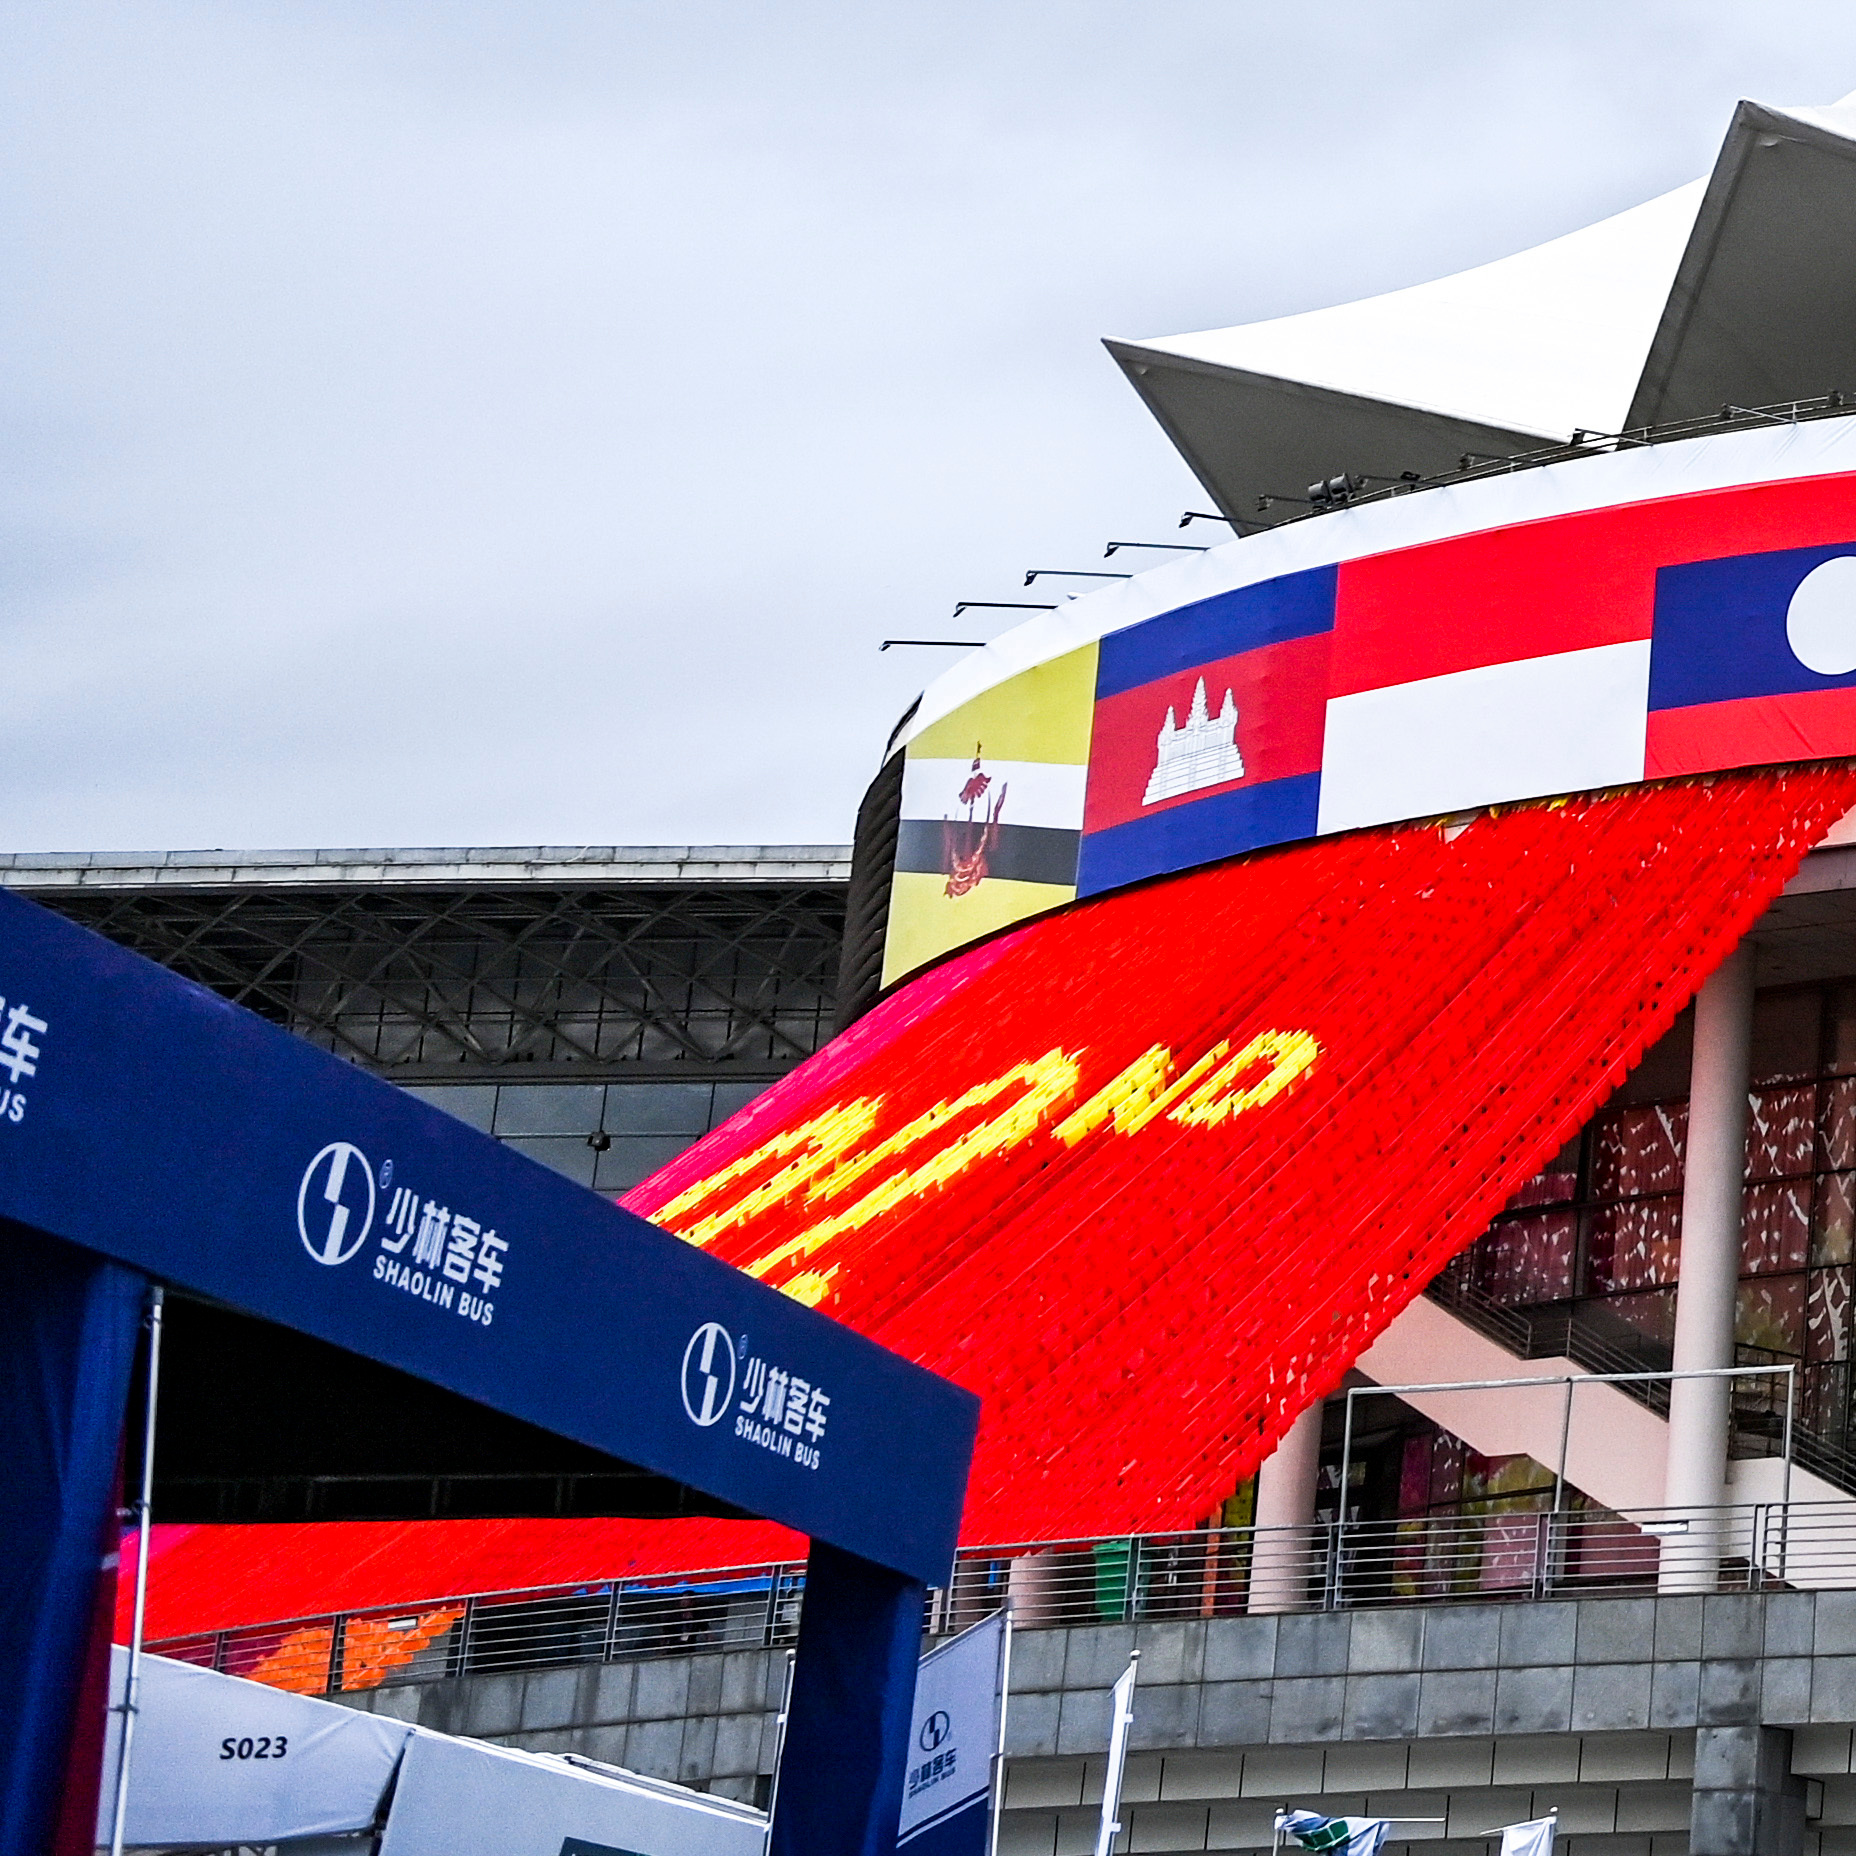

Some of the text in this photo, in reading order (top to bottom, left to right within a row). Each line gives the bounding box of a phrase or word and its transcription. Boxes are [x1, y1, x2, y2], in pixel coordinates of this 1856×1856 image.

[0, 996, 49, 1084] 车
[380, 1186, 510, 1295] 少林客车
[372, 1254, 495, 1326] SHAOLIN BUS
[738, 1357, 832, 1444] 少林客车
[734, 1415, 821, 1471] SHAOLIN BUS
[219, 1735, 289, 1760] S023
